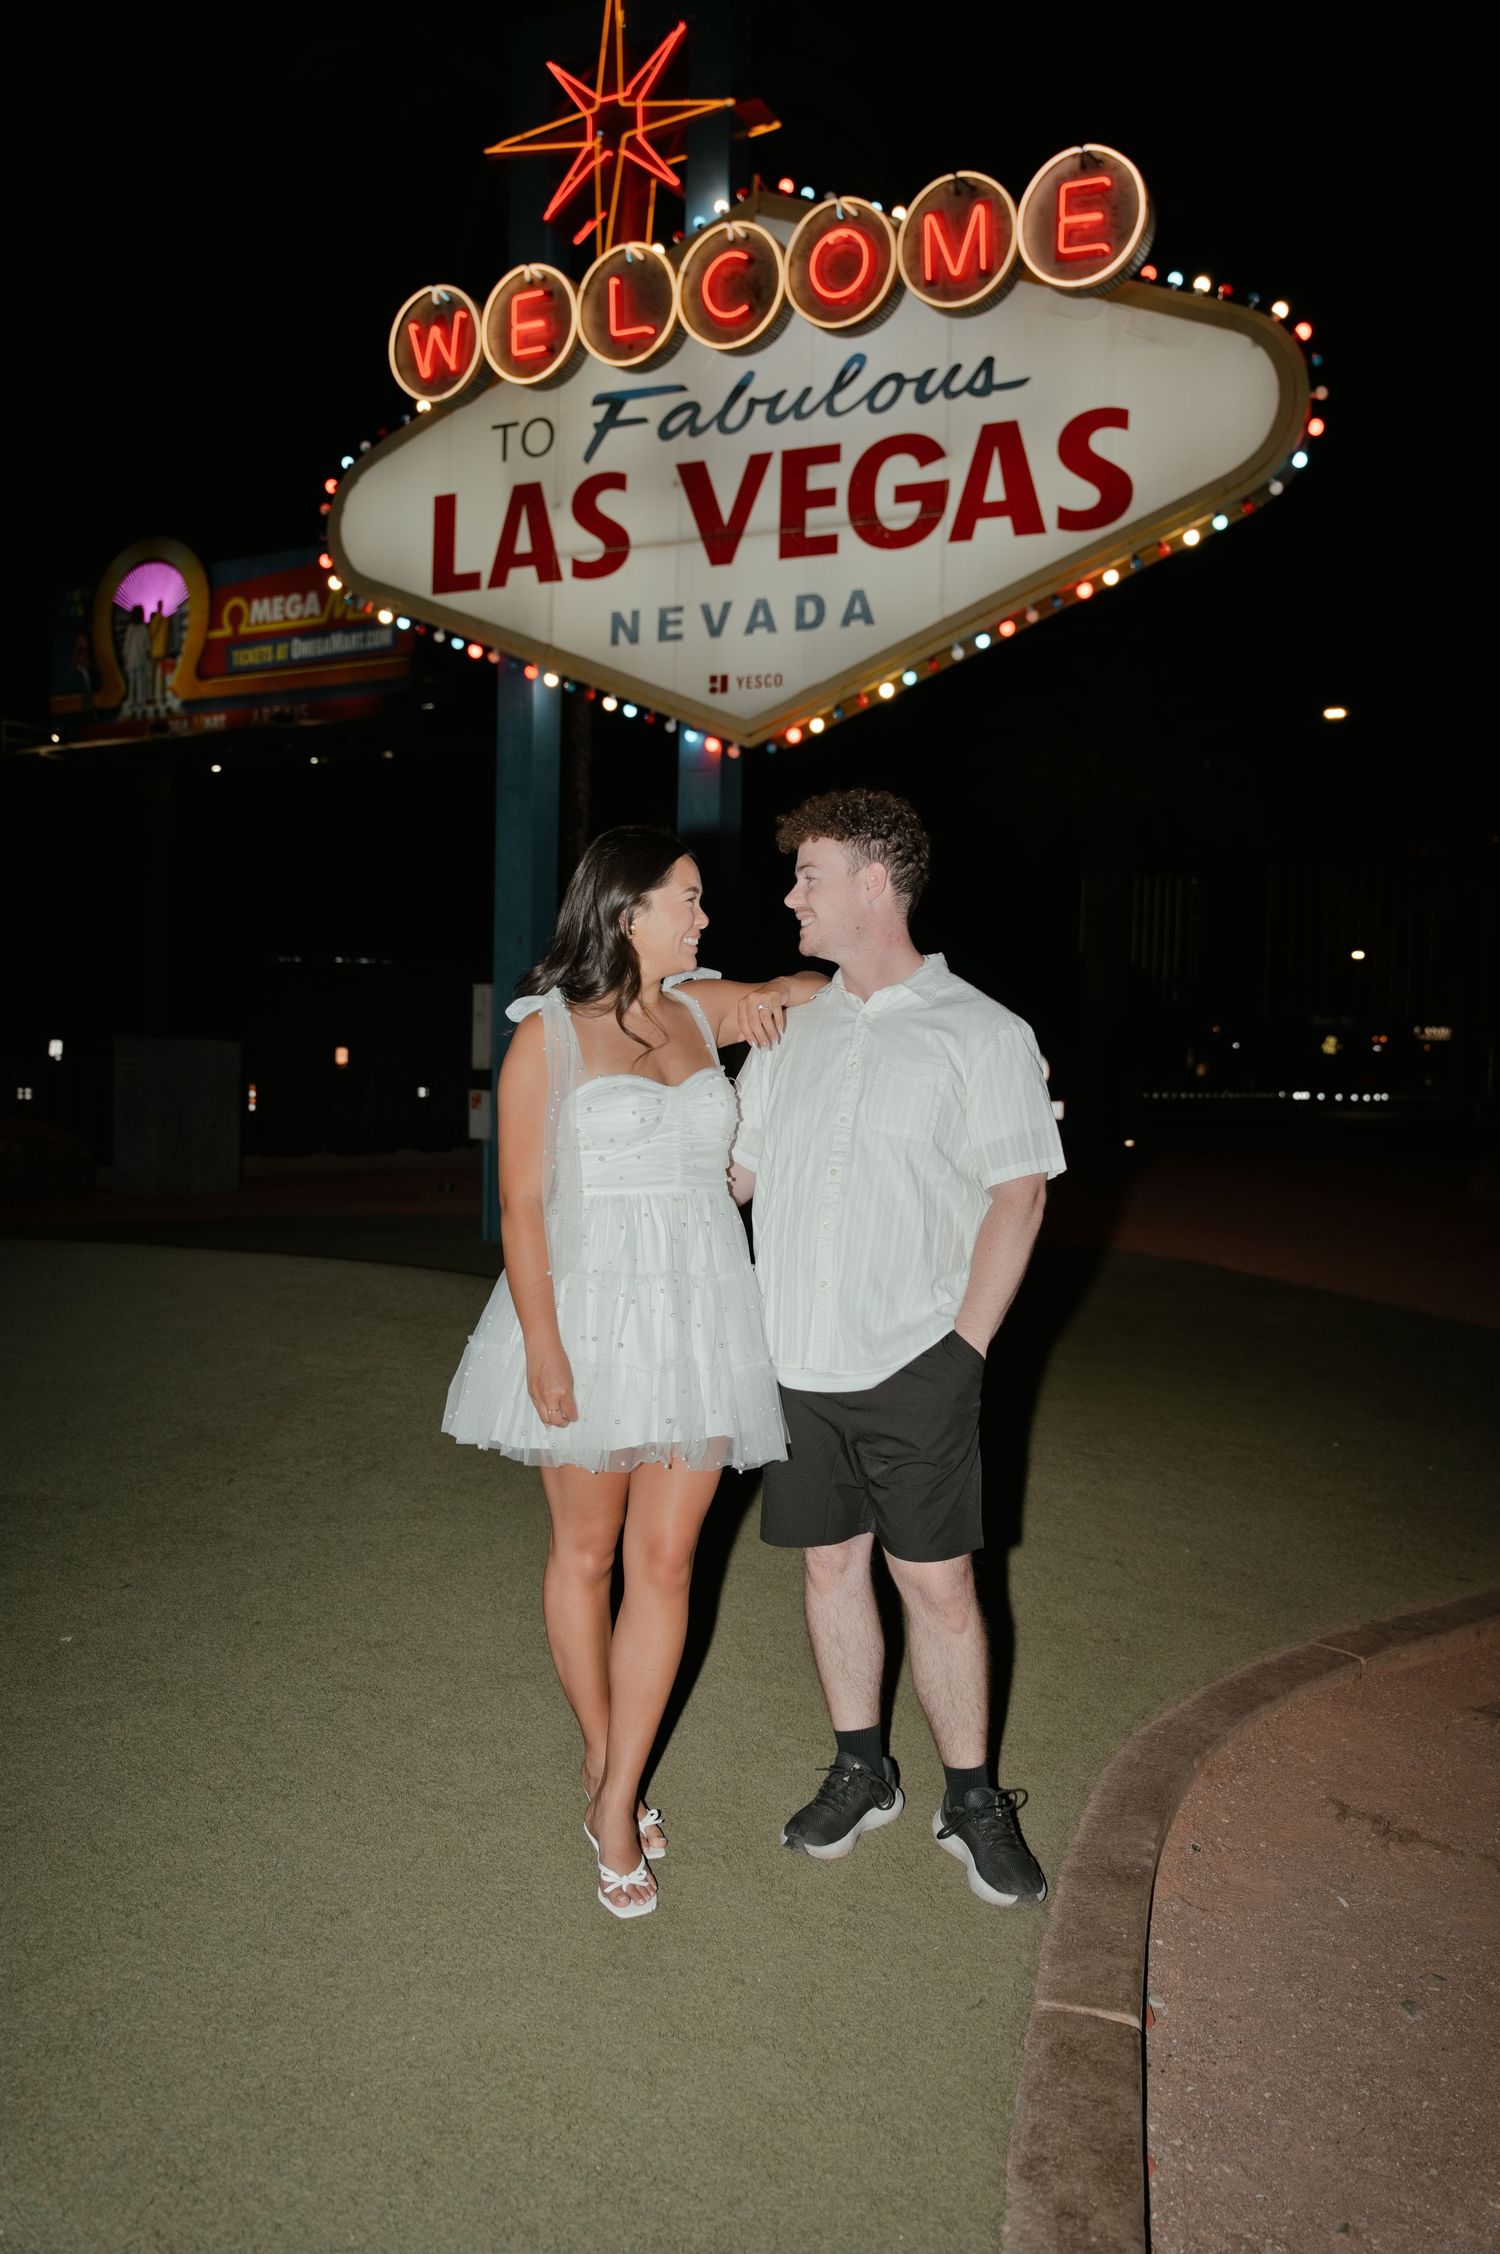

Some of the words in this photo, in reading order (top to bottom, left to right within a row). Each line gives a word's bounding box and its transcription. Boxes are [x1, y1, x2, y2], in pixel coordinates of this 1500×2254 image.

[407, 175, 1113, 380] WELCOME
[491, 417, 555, 462] TO
[583, 353, 1031, 464] Fabulous
[431, 471, 631, 596] LAS
[676, 407, 1135, 566] VEGAS
[609, 589, 875, 647] NEVADA
[735, 673, 784, 691] YESCO
